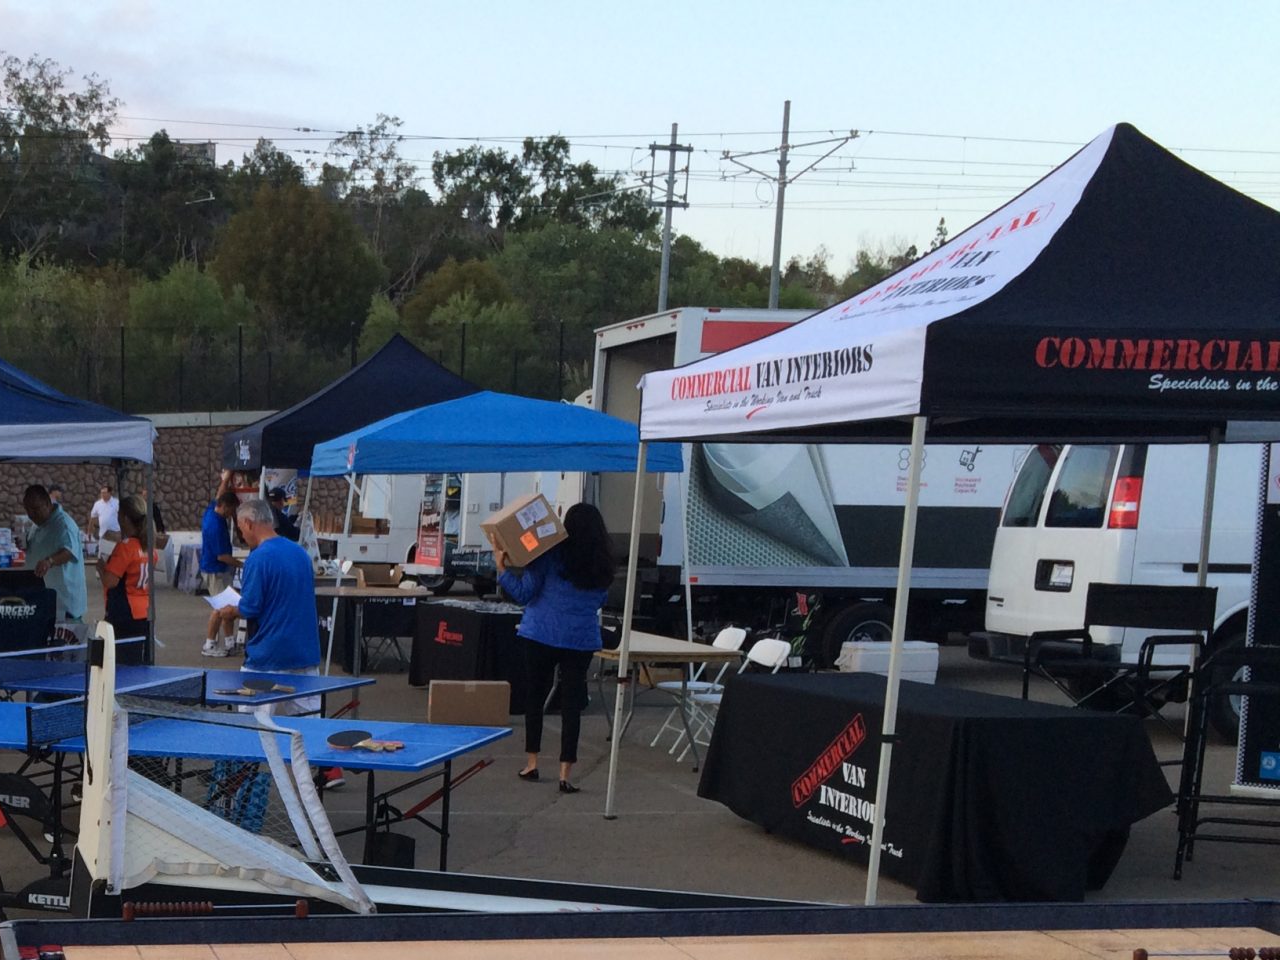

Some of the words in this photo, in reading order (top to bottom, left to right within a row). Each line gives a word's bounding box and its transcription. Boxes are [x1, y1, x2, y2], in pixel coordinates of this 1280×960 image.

[671, 366, 751, 400] COMMERCIAL
[756, 359, 785, 389] VAN
[785, 344, 874, 384] INTERIORS
[1148, 374, 1230, 392] Specialists
[1236, 378, 1252, 391] in
[1256, 375, 1279, 391] the
[793, 719, 865, 804] COMMERCIAL
[842, 761, 866, 788] VAN
[819, 784, 886, 828] INTERIO
